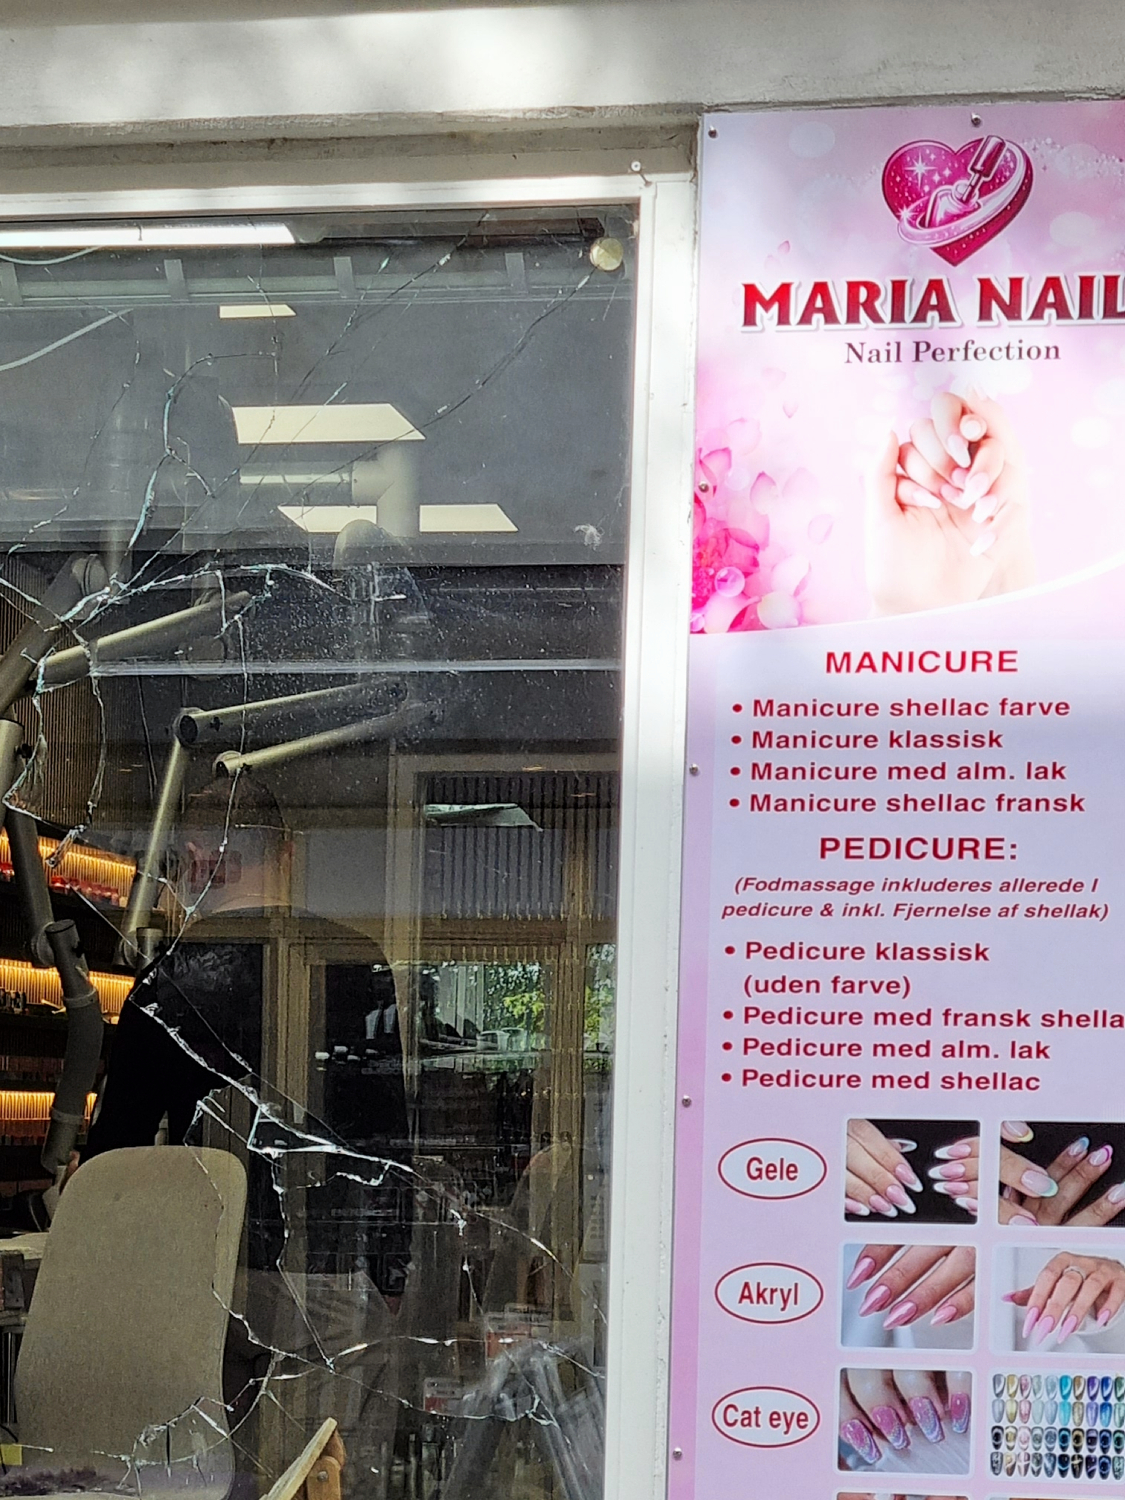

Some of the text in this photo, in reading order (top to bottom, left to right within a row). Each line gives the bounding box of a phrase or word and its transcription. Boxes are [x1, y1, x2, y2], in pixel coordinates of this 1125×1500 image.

[742, 278, 955, 327] MARIA
[847, 340, 1059, 363] Nail Perfection
[827, 651, 1017, 673] MANICURE
[754, 698, 1069, 717] Manicure shellac farve
[753, 730, 1002, 748] Manicure klassisk
[752, 762, 1065, 780] Manicure med alm. lak
[751, 794, 1084, 811] Manicure shellac fransk
[821, 838, 1016, 860] PEDICURE:
[735, 878, 874, 895] (Fodmassage
[882, 878, 992, 892] inkluderes
[999, 878, 1084, 892] allerede
[722, 903, 1108, 921] pedicure & inkl. Fjernelse af shellak)
[747, 942, 988, 961] Pedicure klassisk
[745, 975, 910, 998] (uden farve)
[745, 1007, 862, 1025] Pedicure
[875, 1009, 931, 1026] med
[943, 1009, 1030, 1027] fransk
[744, 1038, 1049, 1058] Pedicure med alm. lak
[743, 1069, 1039, 1090] Pedicure med shellac
[746, 1157, 798, 1181] Gele
[737, 1281, 799, 1307] Akryl
[722, 1404, 809, 1434] Cat eye
